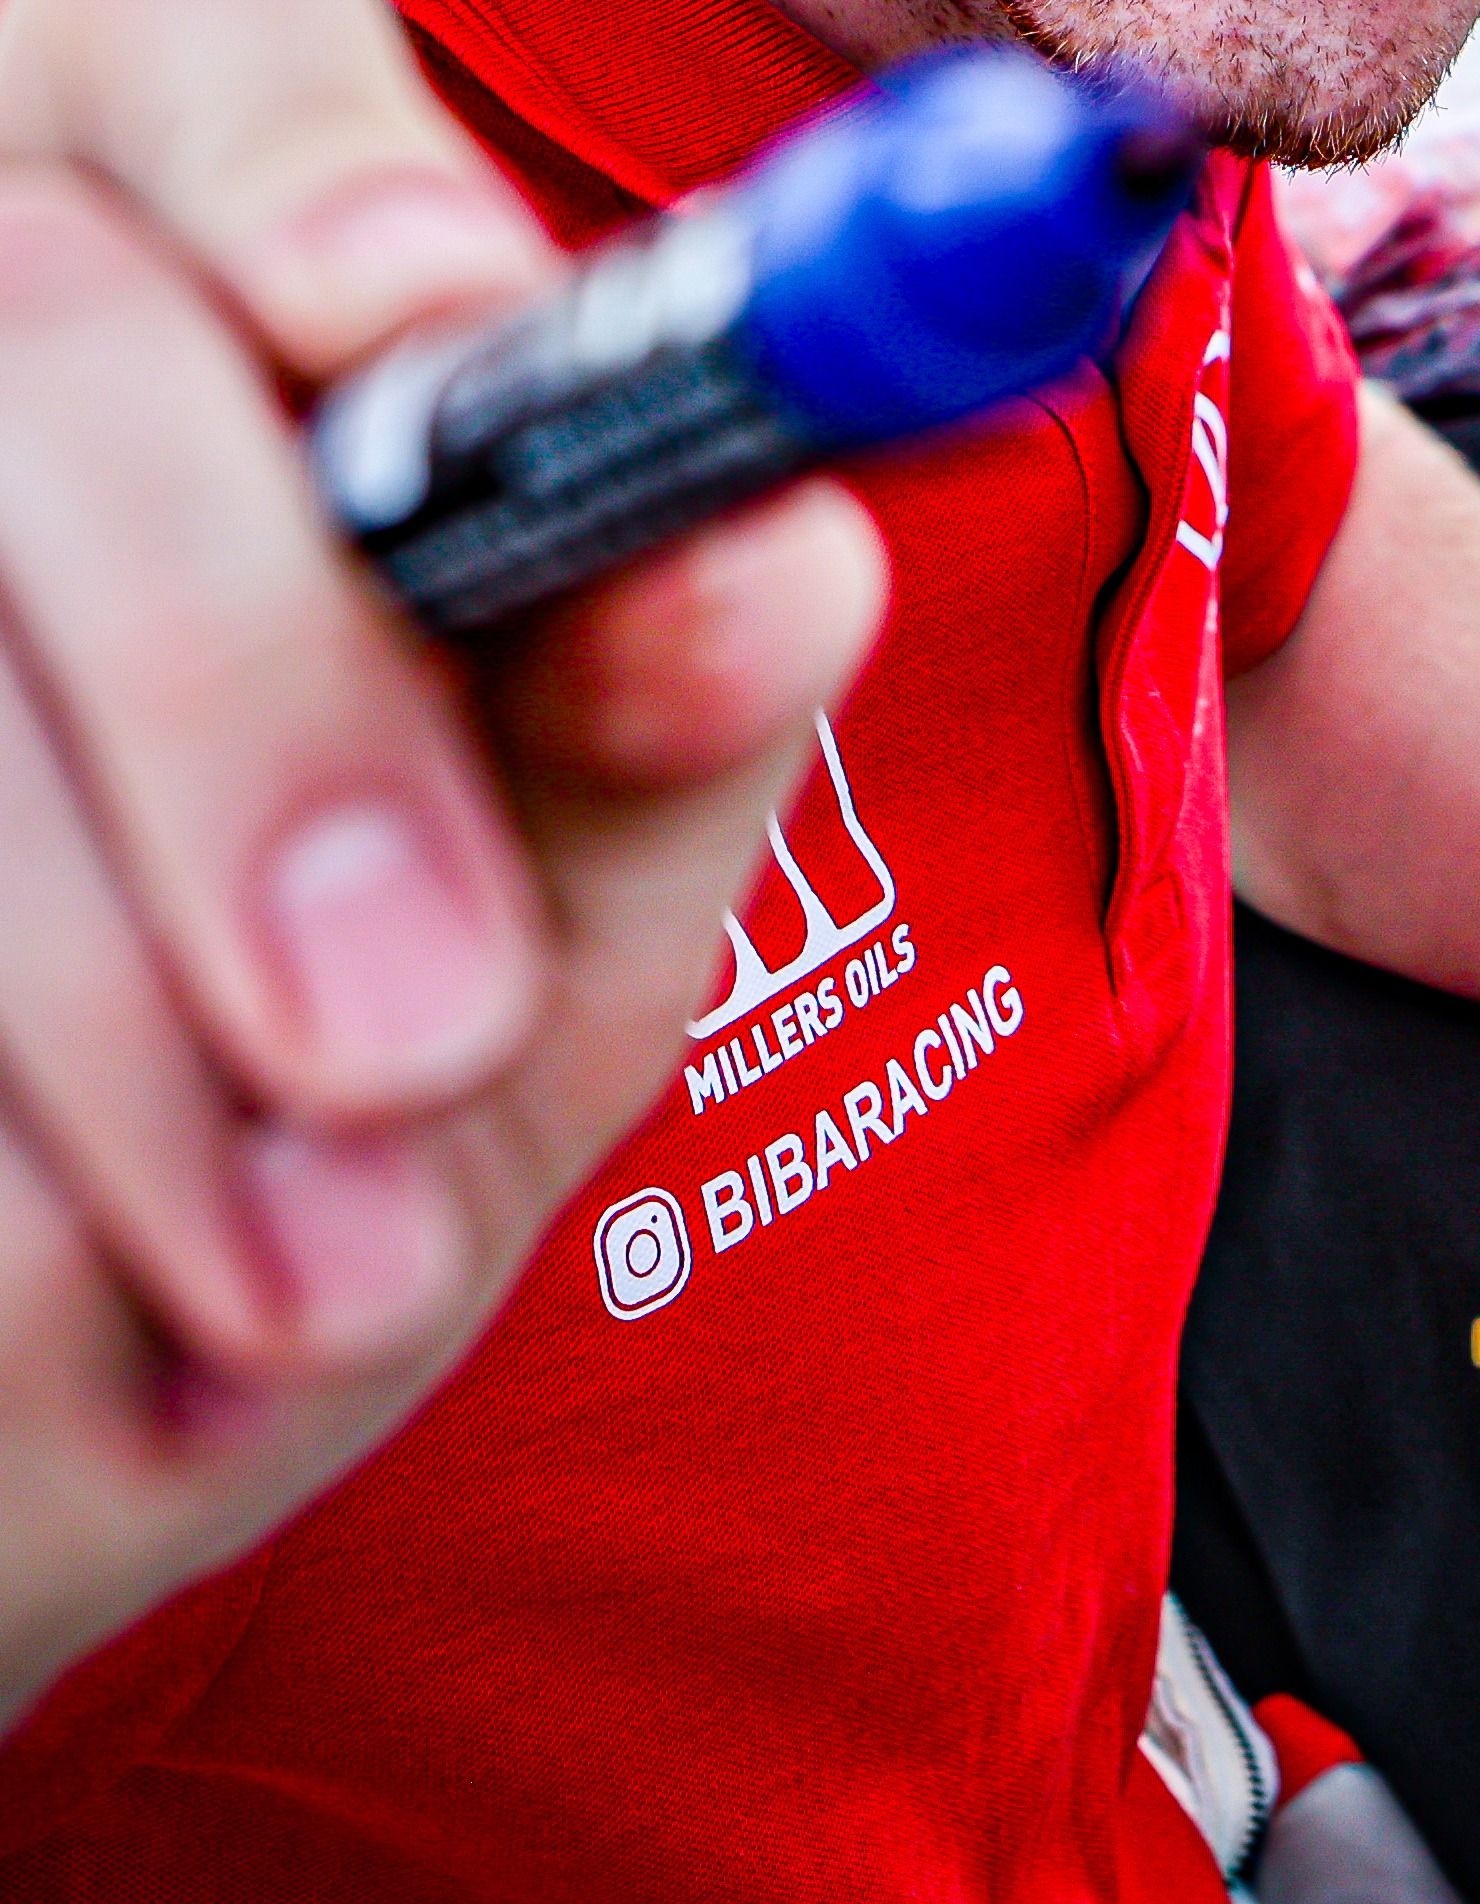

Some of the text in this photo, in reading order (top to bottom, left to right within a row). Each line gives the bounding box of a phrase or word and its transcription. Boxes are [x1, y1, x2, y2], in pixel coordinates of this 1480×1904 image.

[684, 923, 917, 1116] MILLERS OILS
[699, 964, 1026, 1254] BIBARACING
